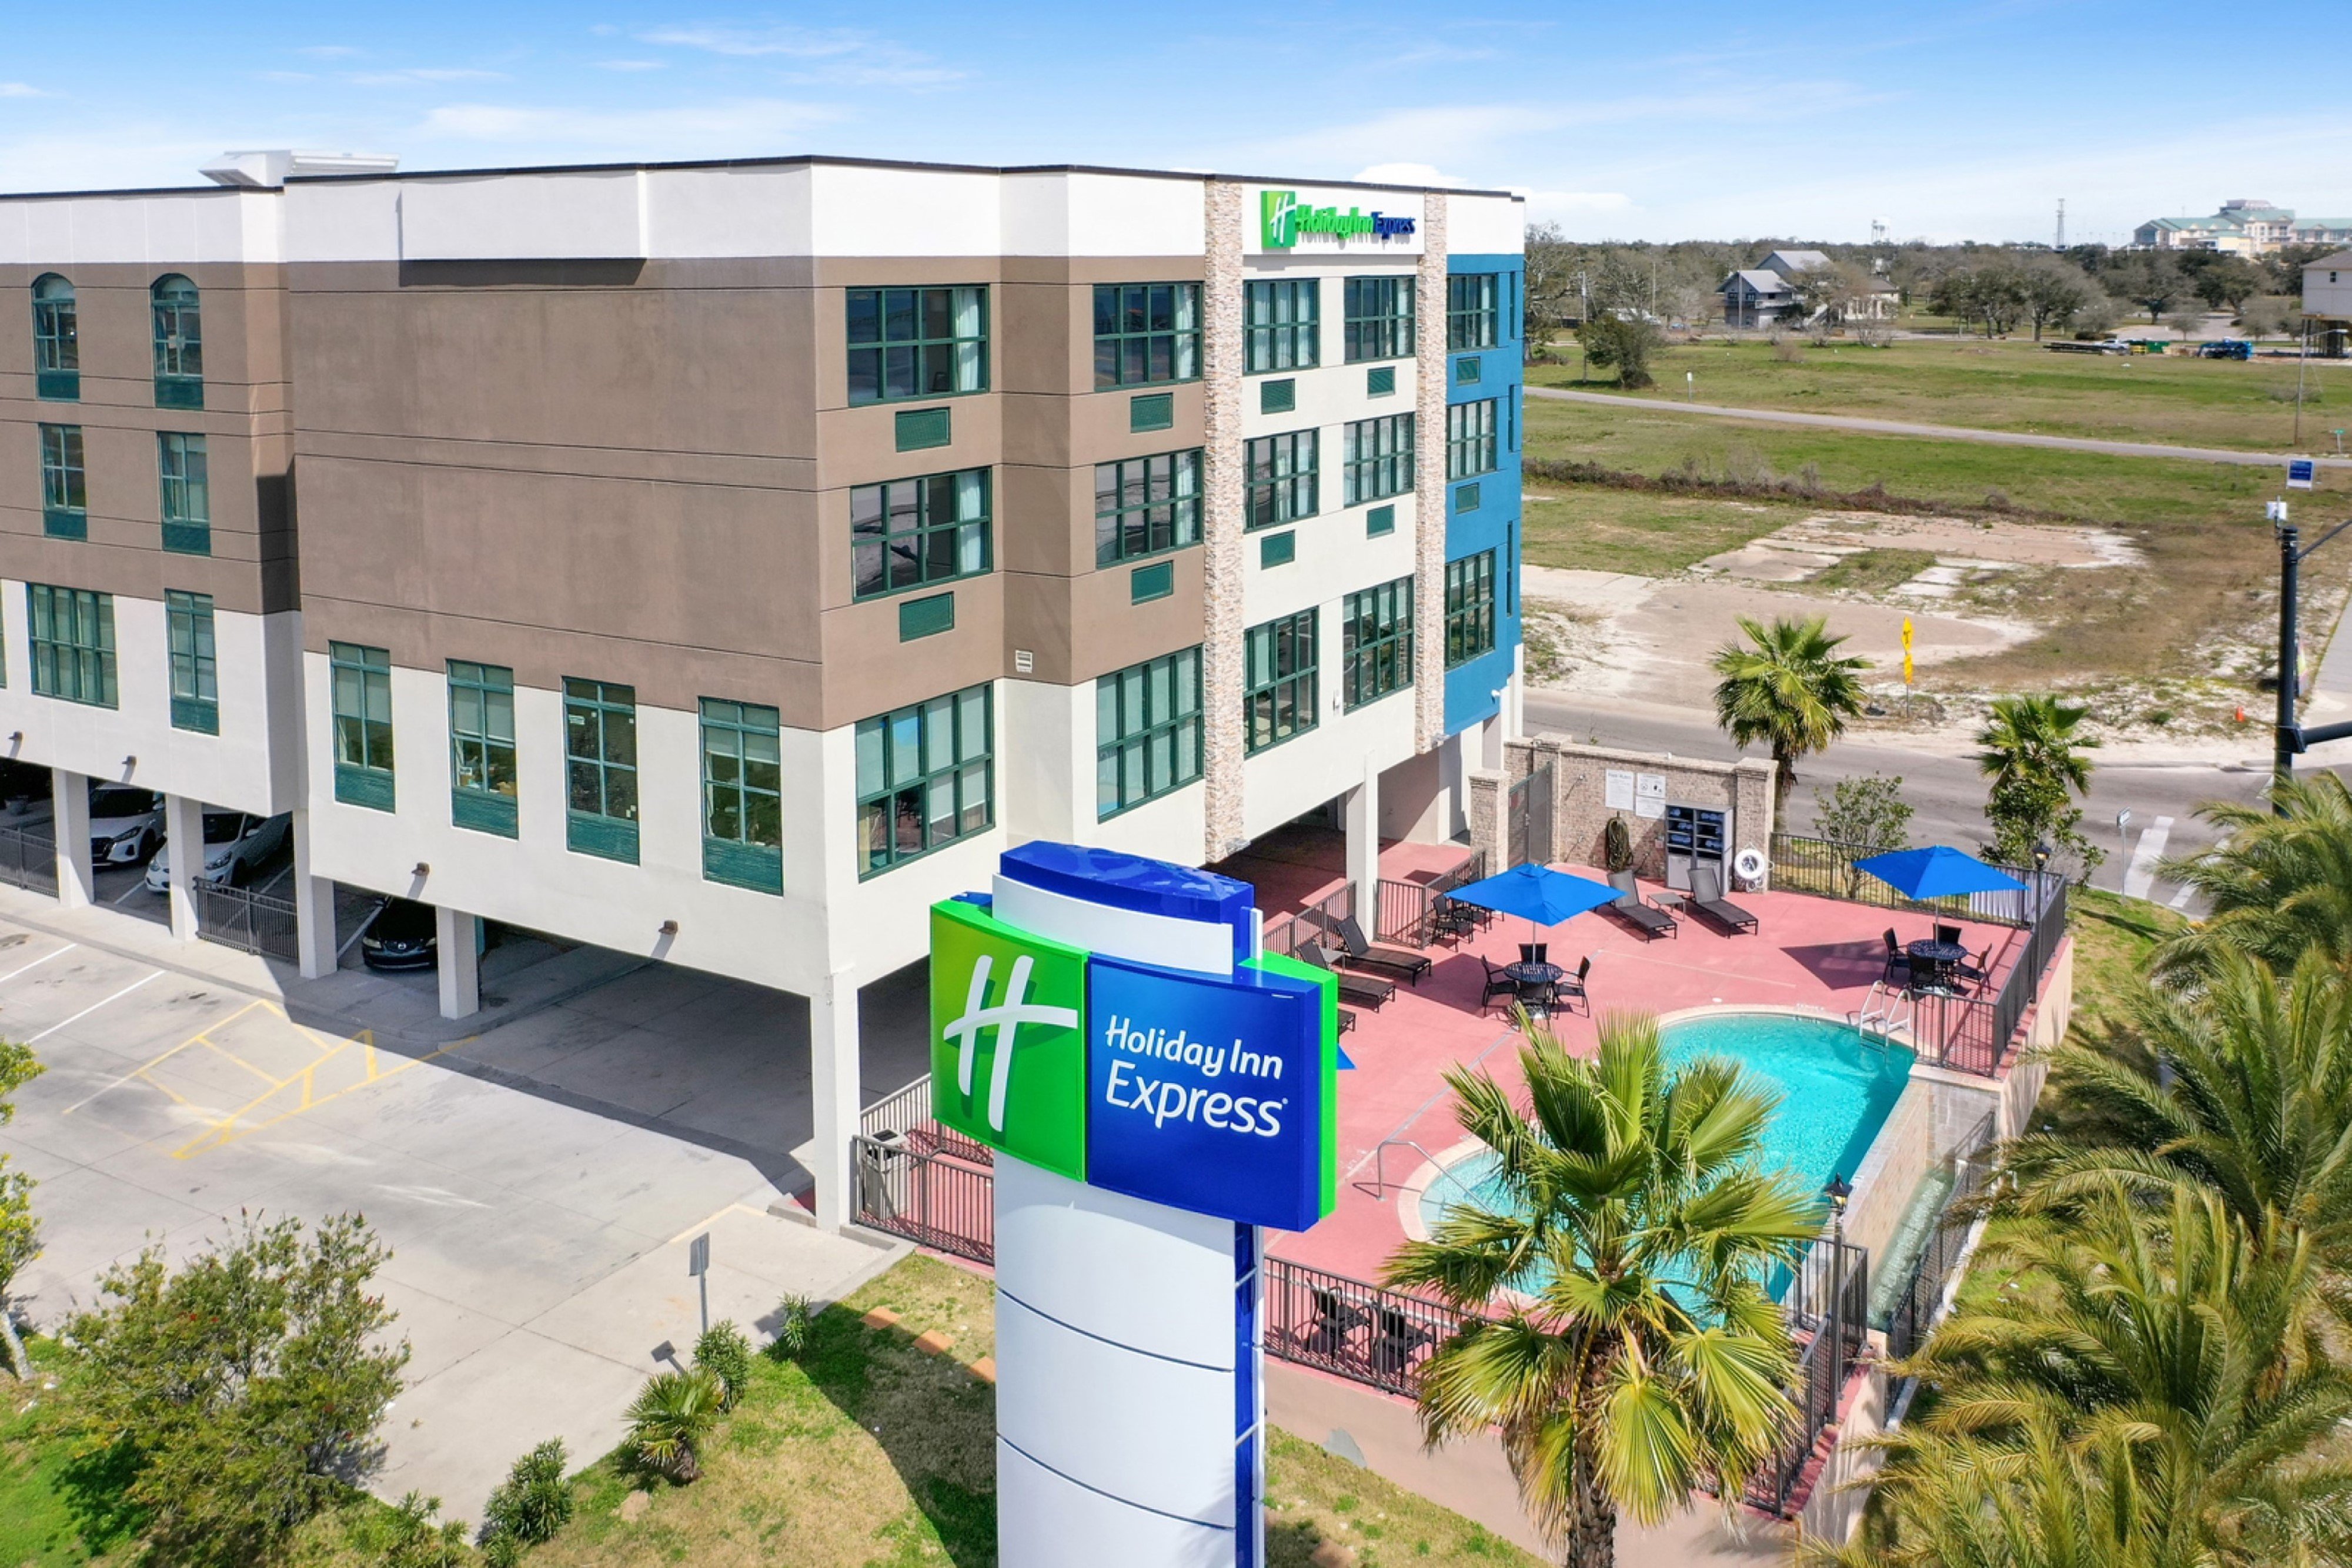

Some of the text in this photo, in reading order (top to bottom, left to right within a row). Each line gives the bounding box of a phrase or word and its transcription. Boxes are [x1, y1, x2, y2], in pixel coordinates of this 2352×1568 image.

[1295, 205, 1415, 240] Holiday Inn Express
[1105, 1014, 1282, 1079] Holiday Inn
[1106, 1059, 1283, 1136] Express
